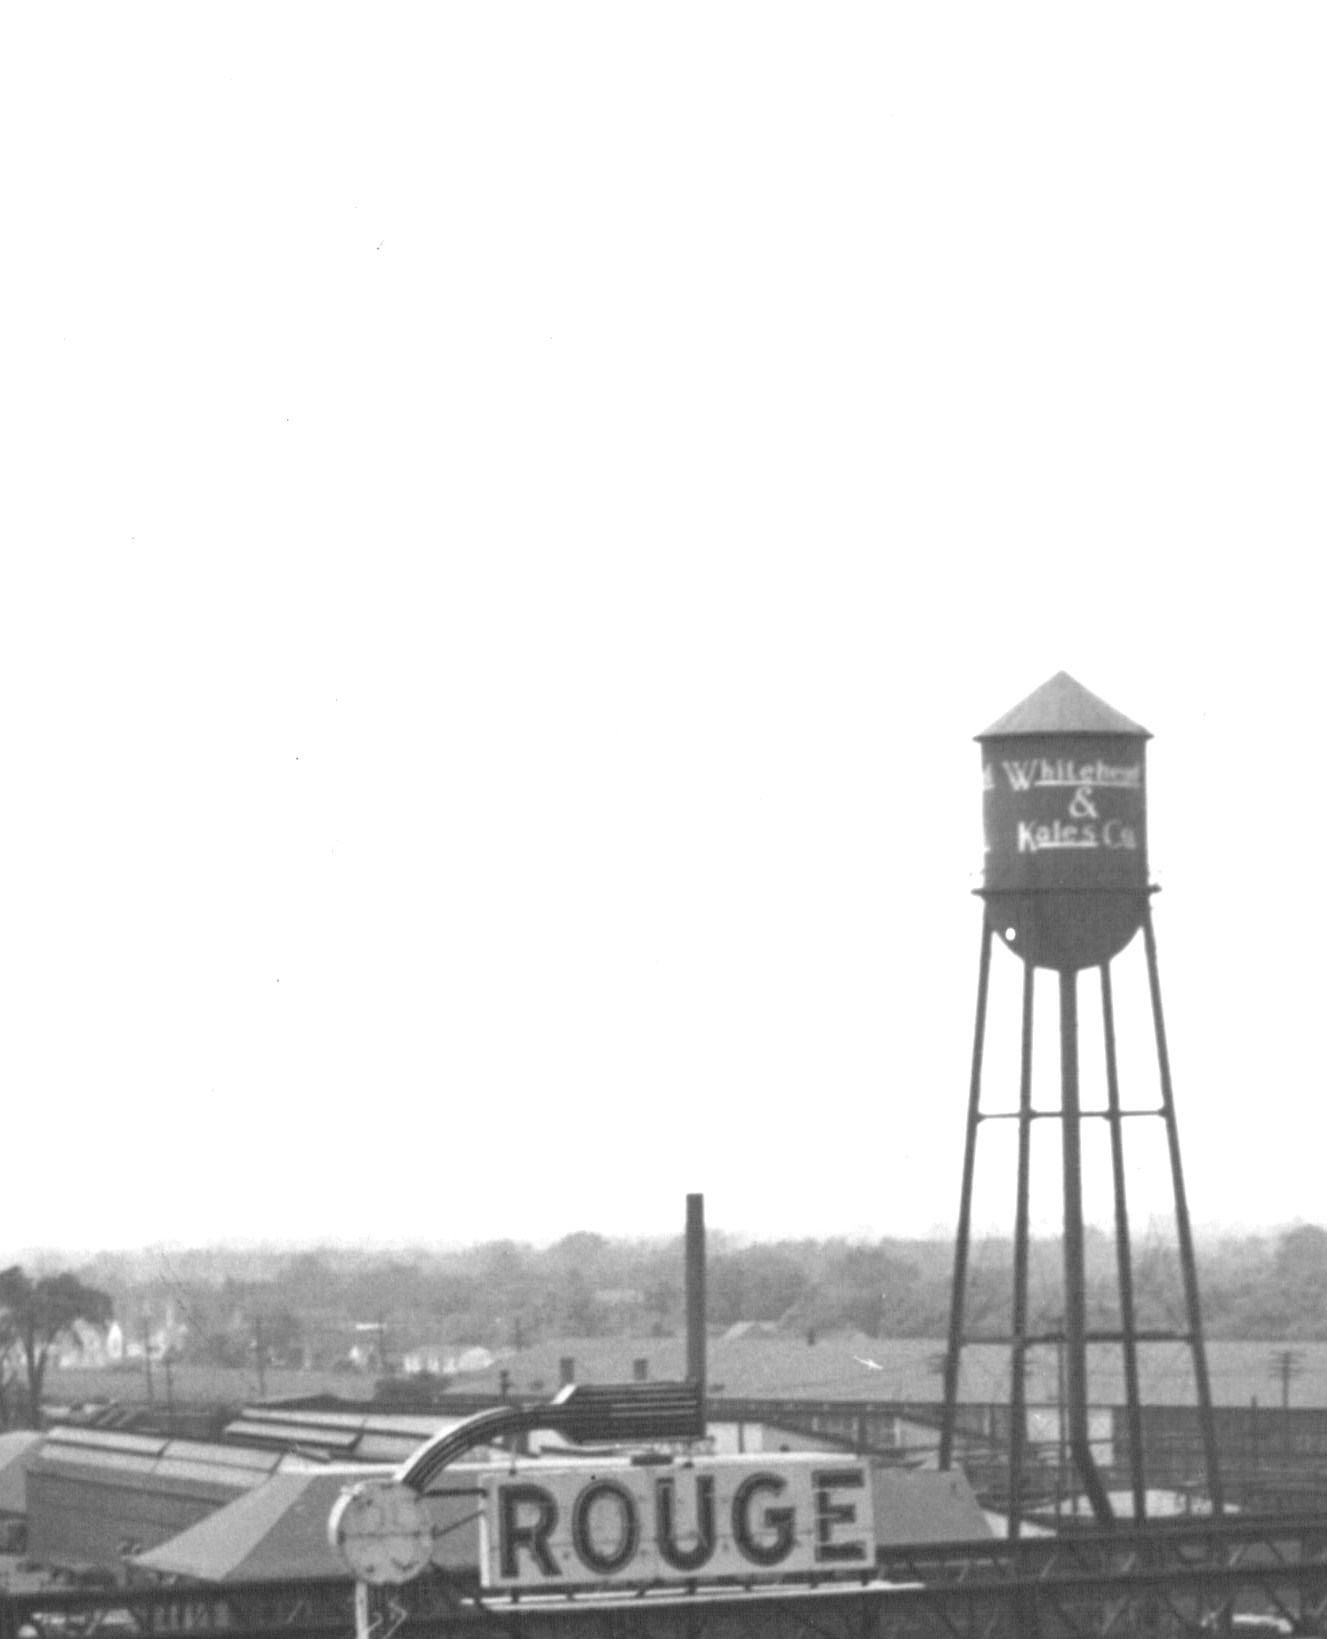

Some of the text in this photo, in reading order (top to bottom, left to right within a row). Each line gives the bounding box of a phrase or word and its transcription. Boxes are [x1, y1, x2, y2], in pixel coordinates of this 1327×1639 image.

[1068, 786, 1098, 818] &
[1018, 819, 1098, 852] Kales
[498, 1468, 866, 1577] ROUGE
